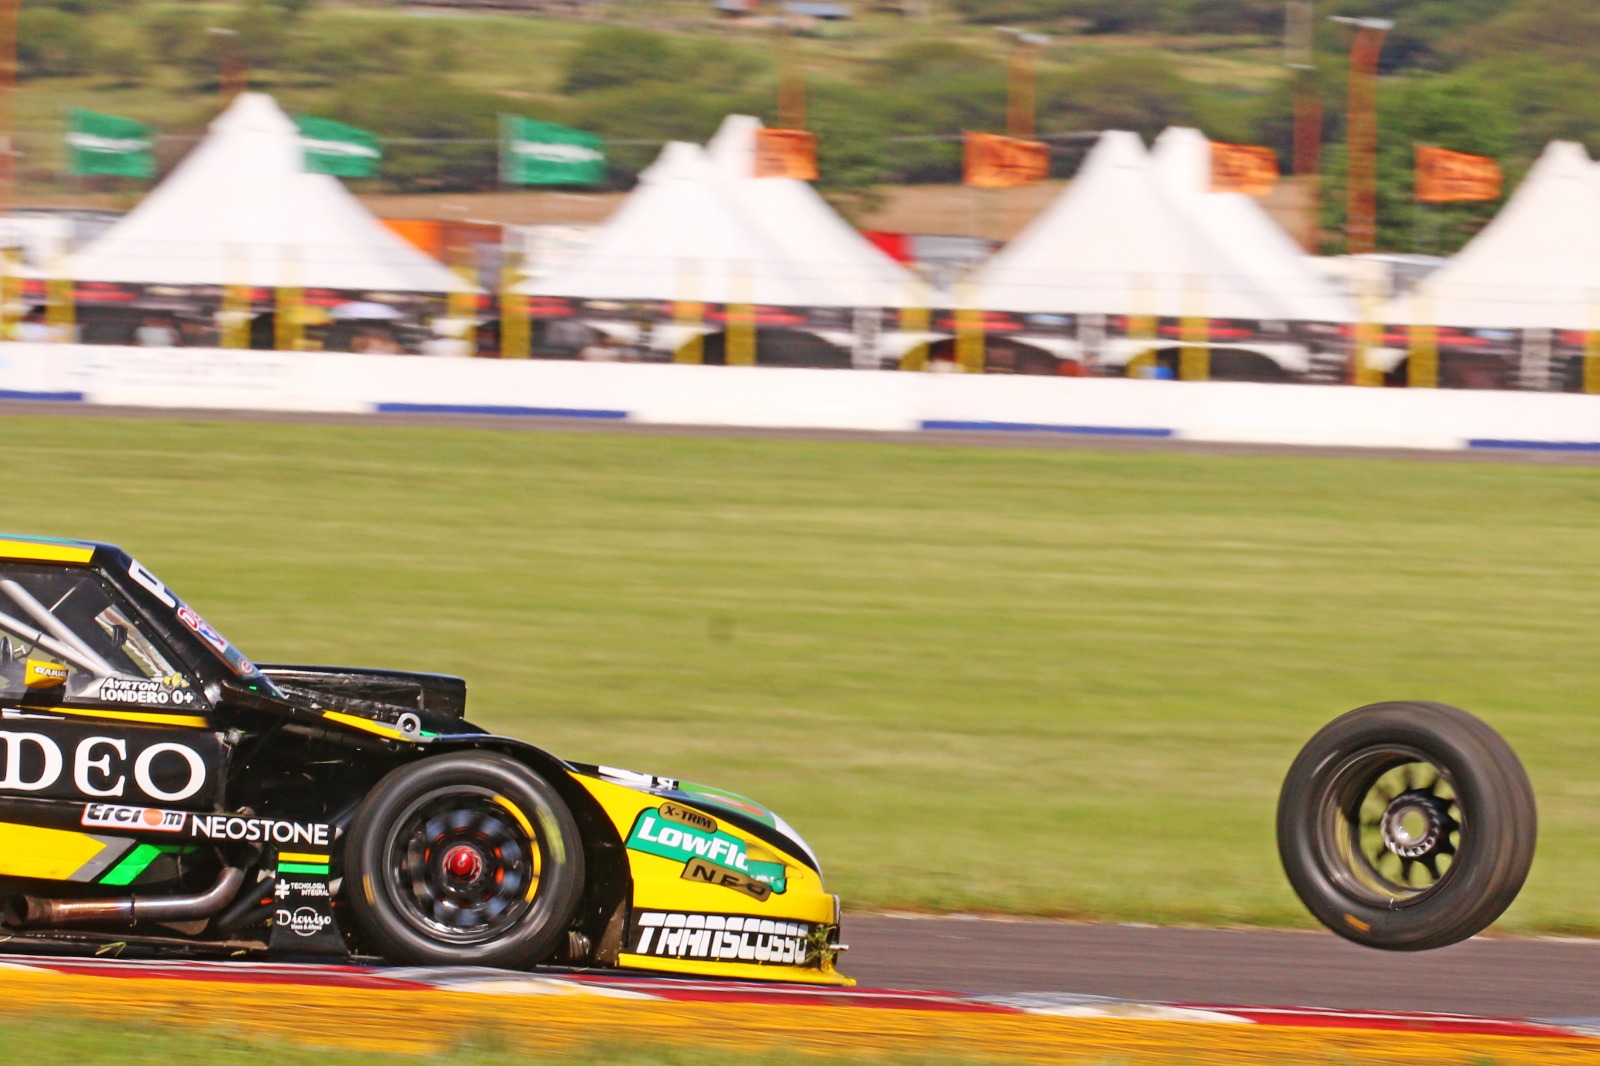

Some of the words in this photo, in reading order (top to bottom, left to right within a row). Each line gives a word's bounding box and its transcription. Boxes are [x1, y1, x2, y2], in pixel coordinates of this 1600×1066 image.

[102, 678, 159, 691] AYRTON
[100, 688, 169, 704] LONDERO
[664, 805, 712, 829] X-TRIM
[192, 814, 329, 845] NEOSTONE
[301, 889, 330, 897] INTEGRAL
[276, 909, 332, 926] Dioniso
